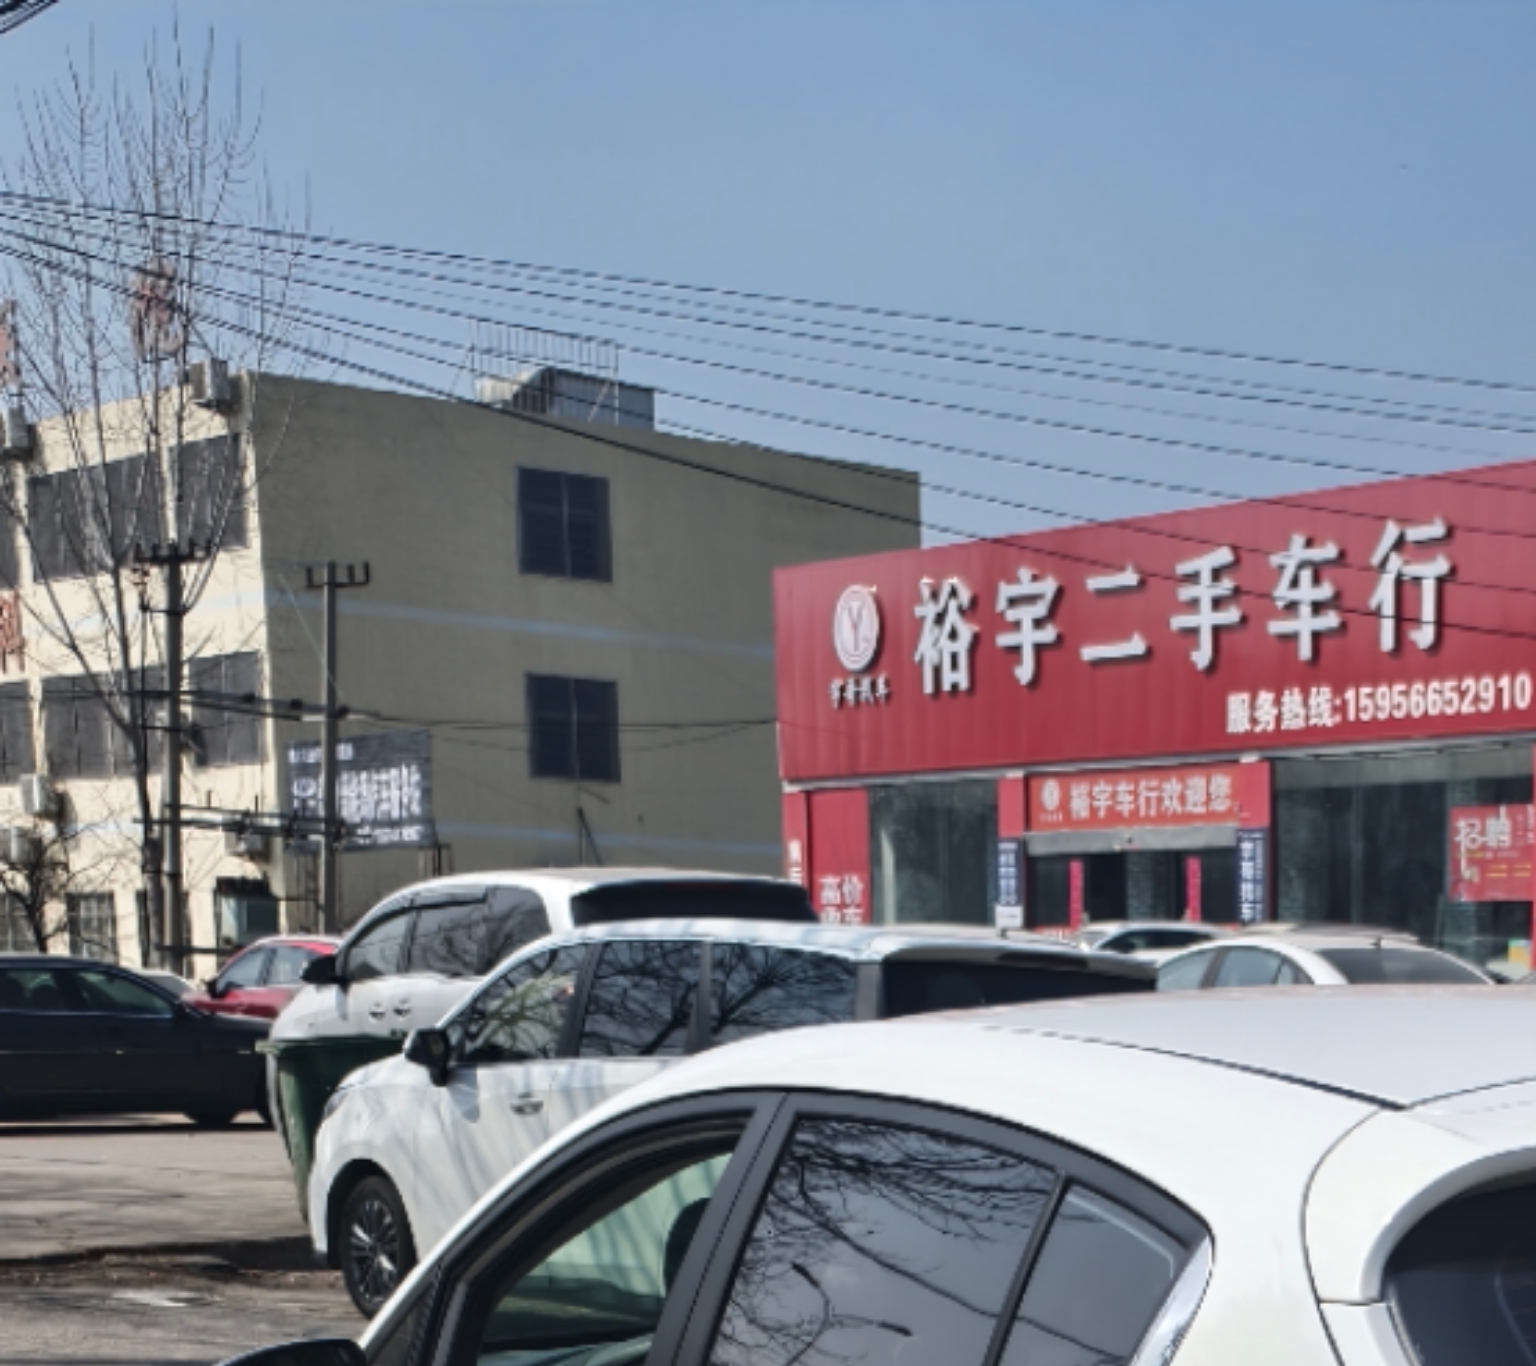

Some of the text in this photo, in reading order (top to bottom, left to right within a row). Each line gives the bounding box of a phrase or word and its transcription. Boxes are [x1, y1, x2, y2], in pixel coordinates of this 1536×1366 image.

[914, 517, 1451, 694] 裕宇二手车行
[1225, 672, 1533, 733] 服务热线:15956652910
[1069, 774, 1232, 820] 裕宇车行欢迎您
